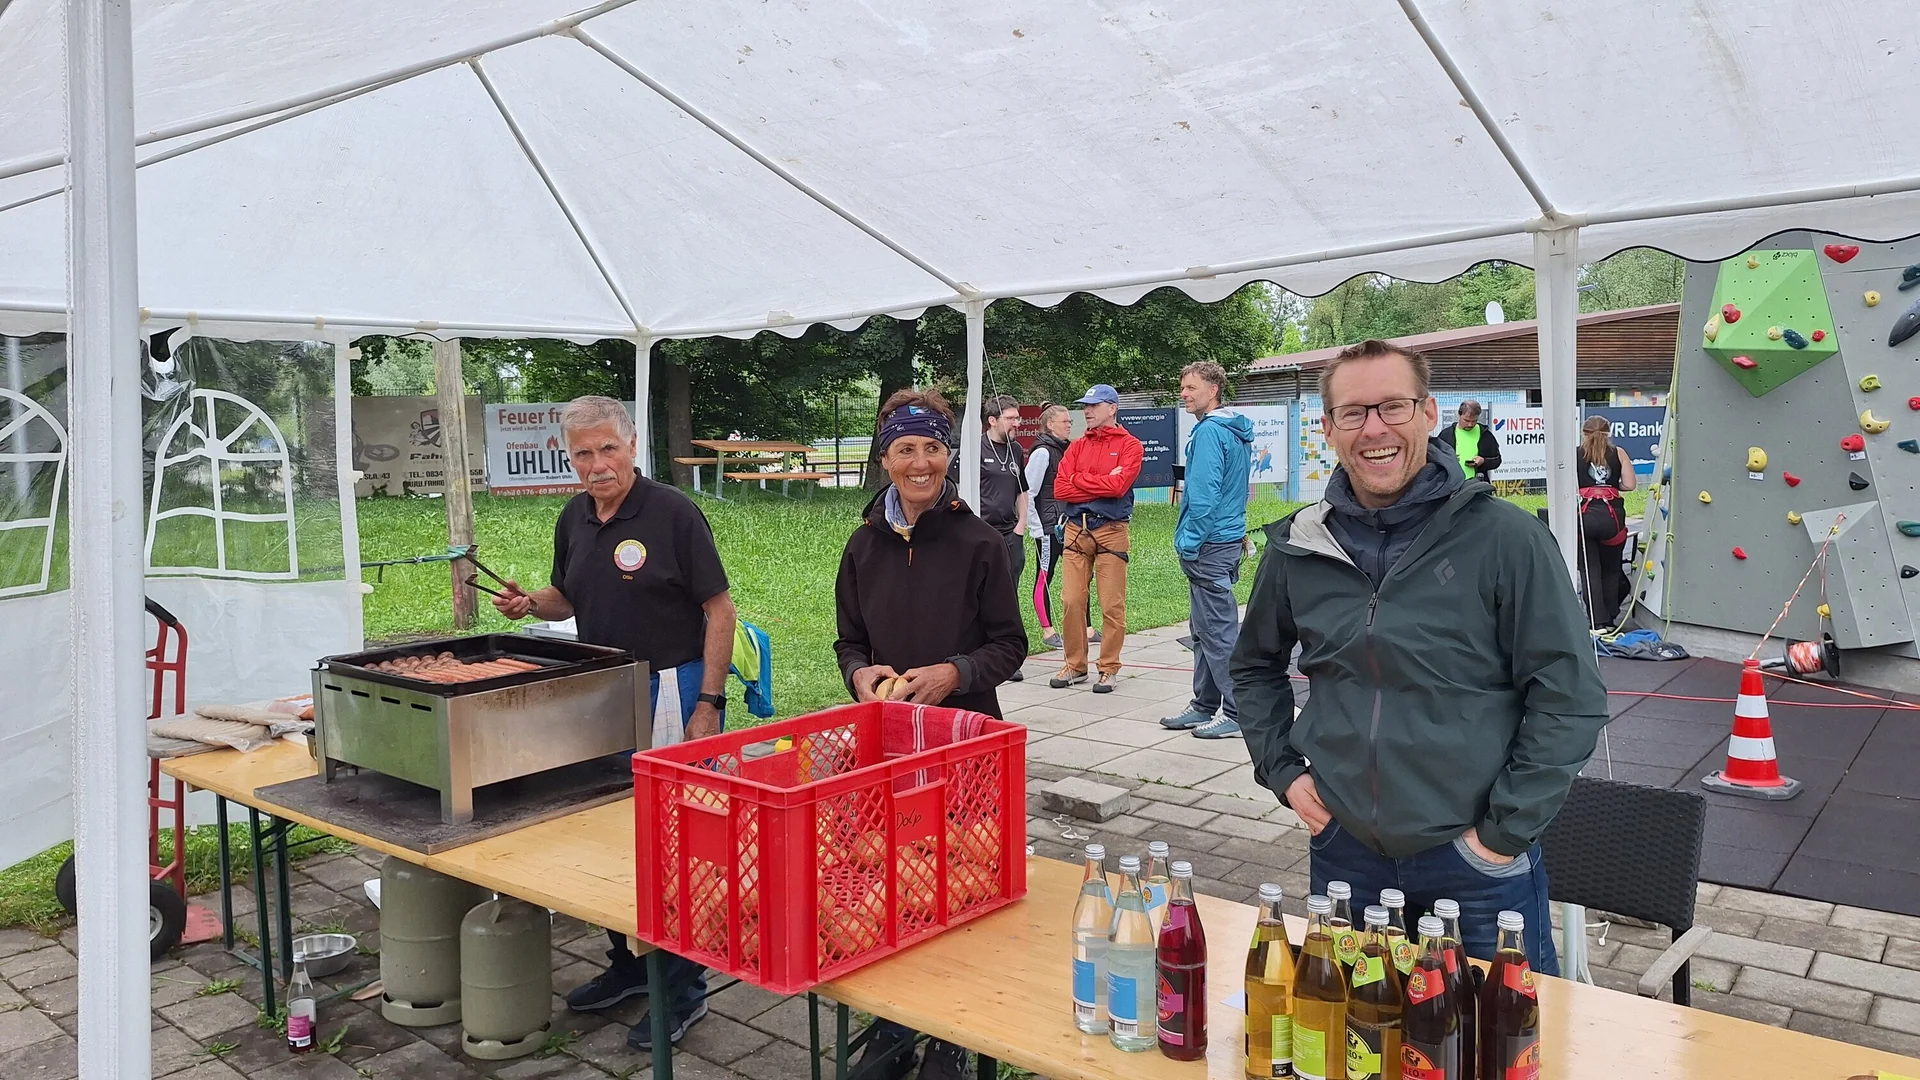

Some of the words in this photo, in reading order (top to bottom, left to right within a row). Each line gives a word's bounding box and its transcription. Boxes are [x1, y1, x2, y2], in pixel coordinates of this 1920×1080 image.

[498, 409, 545, 424] Feuer
[548, 407, 562, 423] fr
[1629, 421, 1663, 437] Bank
[506, 442, 539, 450] Ofenbau
[1506, 433, 1545, 445] HOFMA
[506, 449, 572, 475] UHLIR
